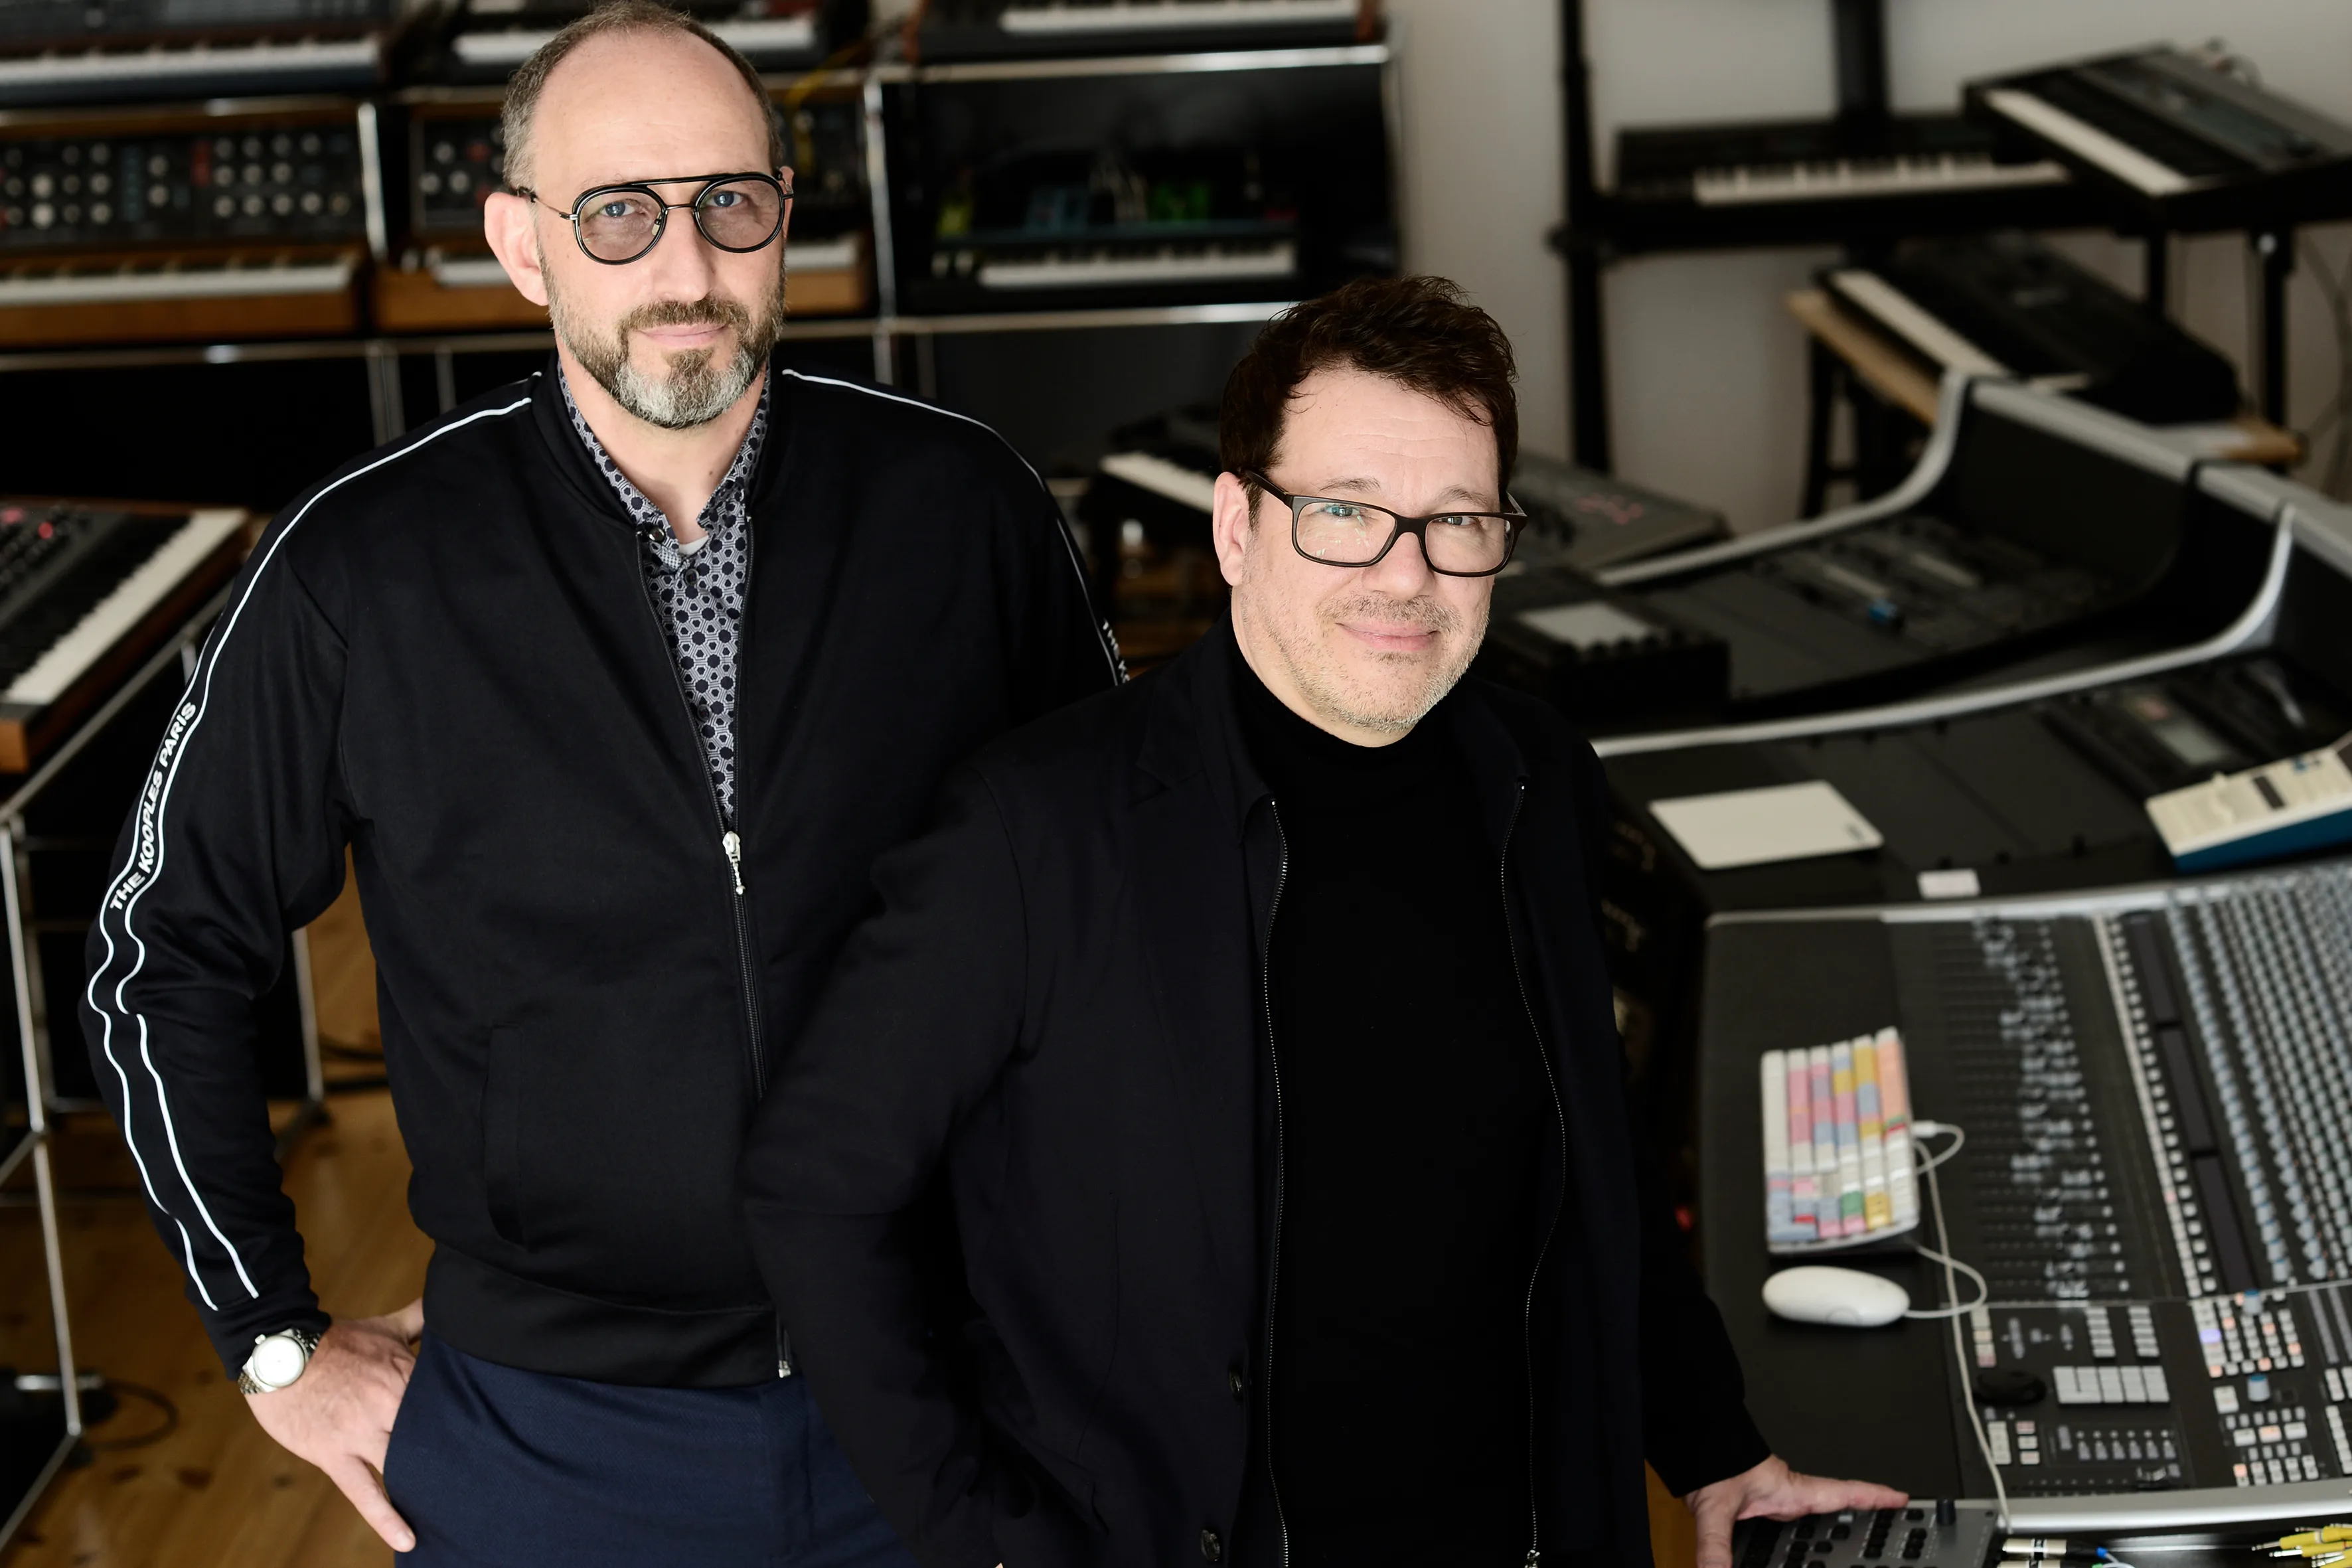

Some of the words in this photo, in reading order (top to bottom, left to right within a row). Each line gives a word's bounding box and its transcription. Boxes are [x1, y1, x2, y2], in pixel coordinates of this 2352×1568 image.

[110, 872, 145, 911] THE
[137, 770, 163, 874] KOOPLES
[159, 702, 196, 767] PARIS
